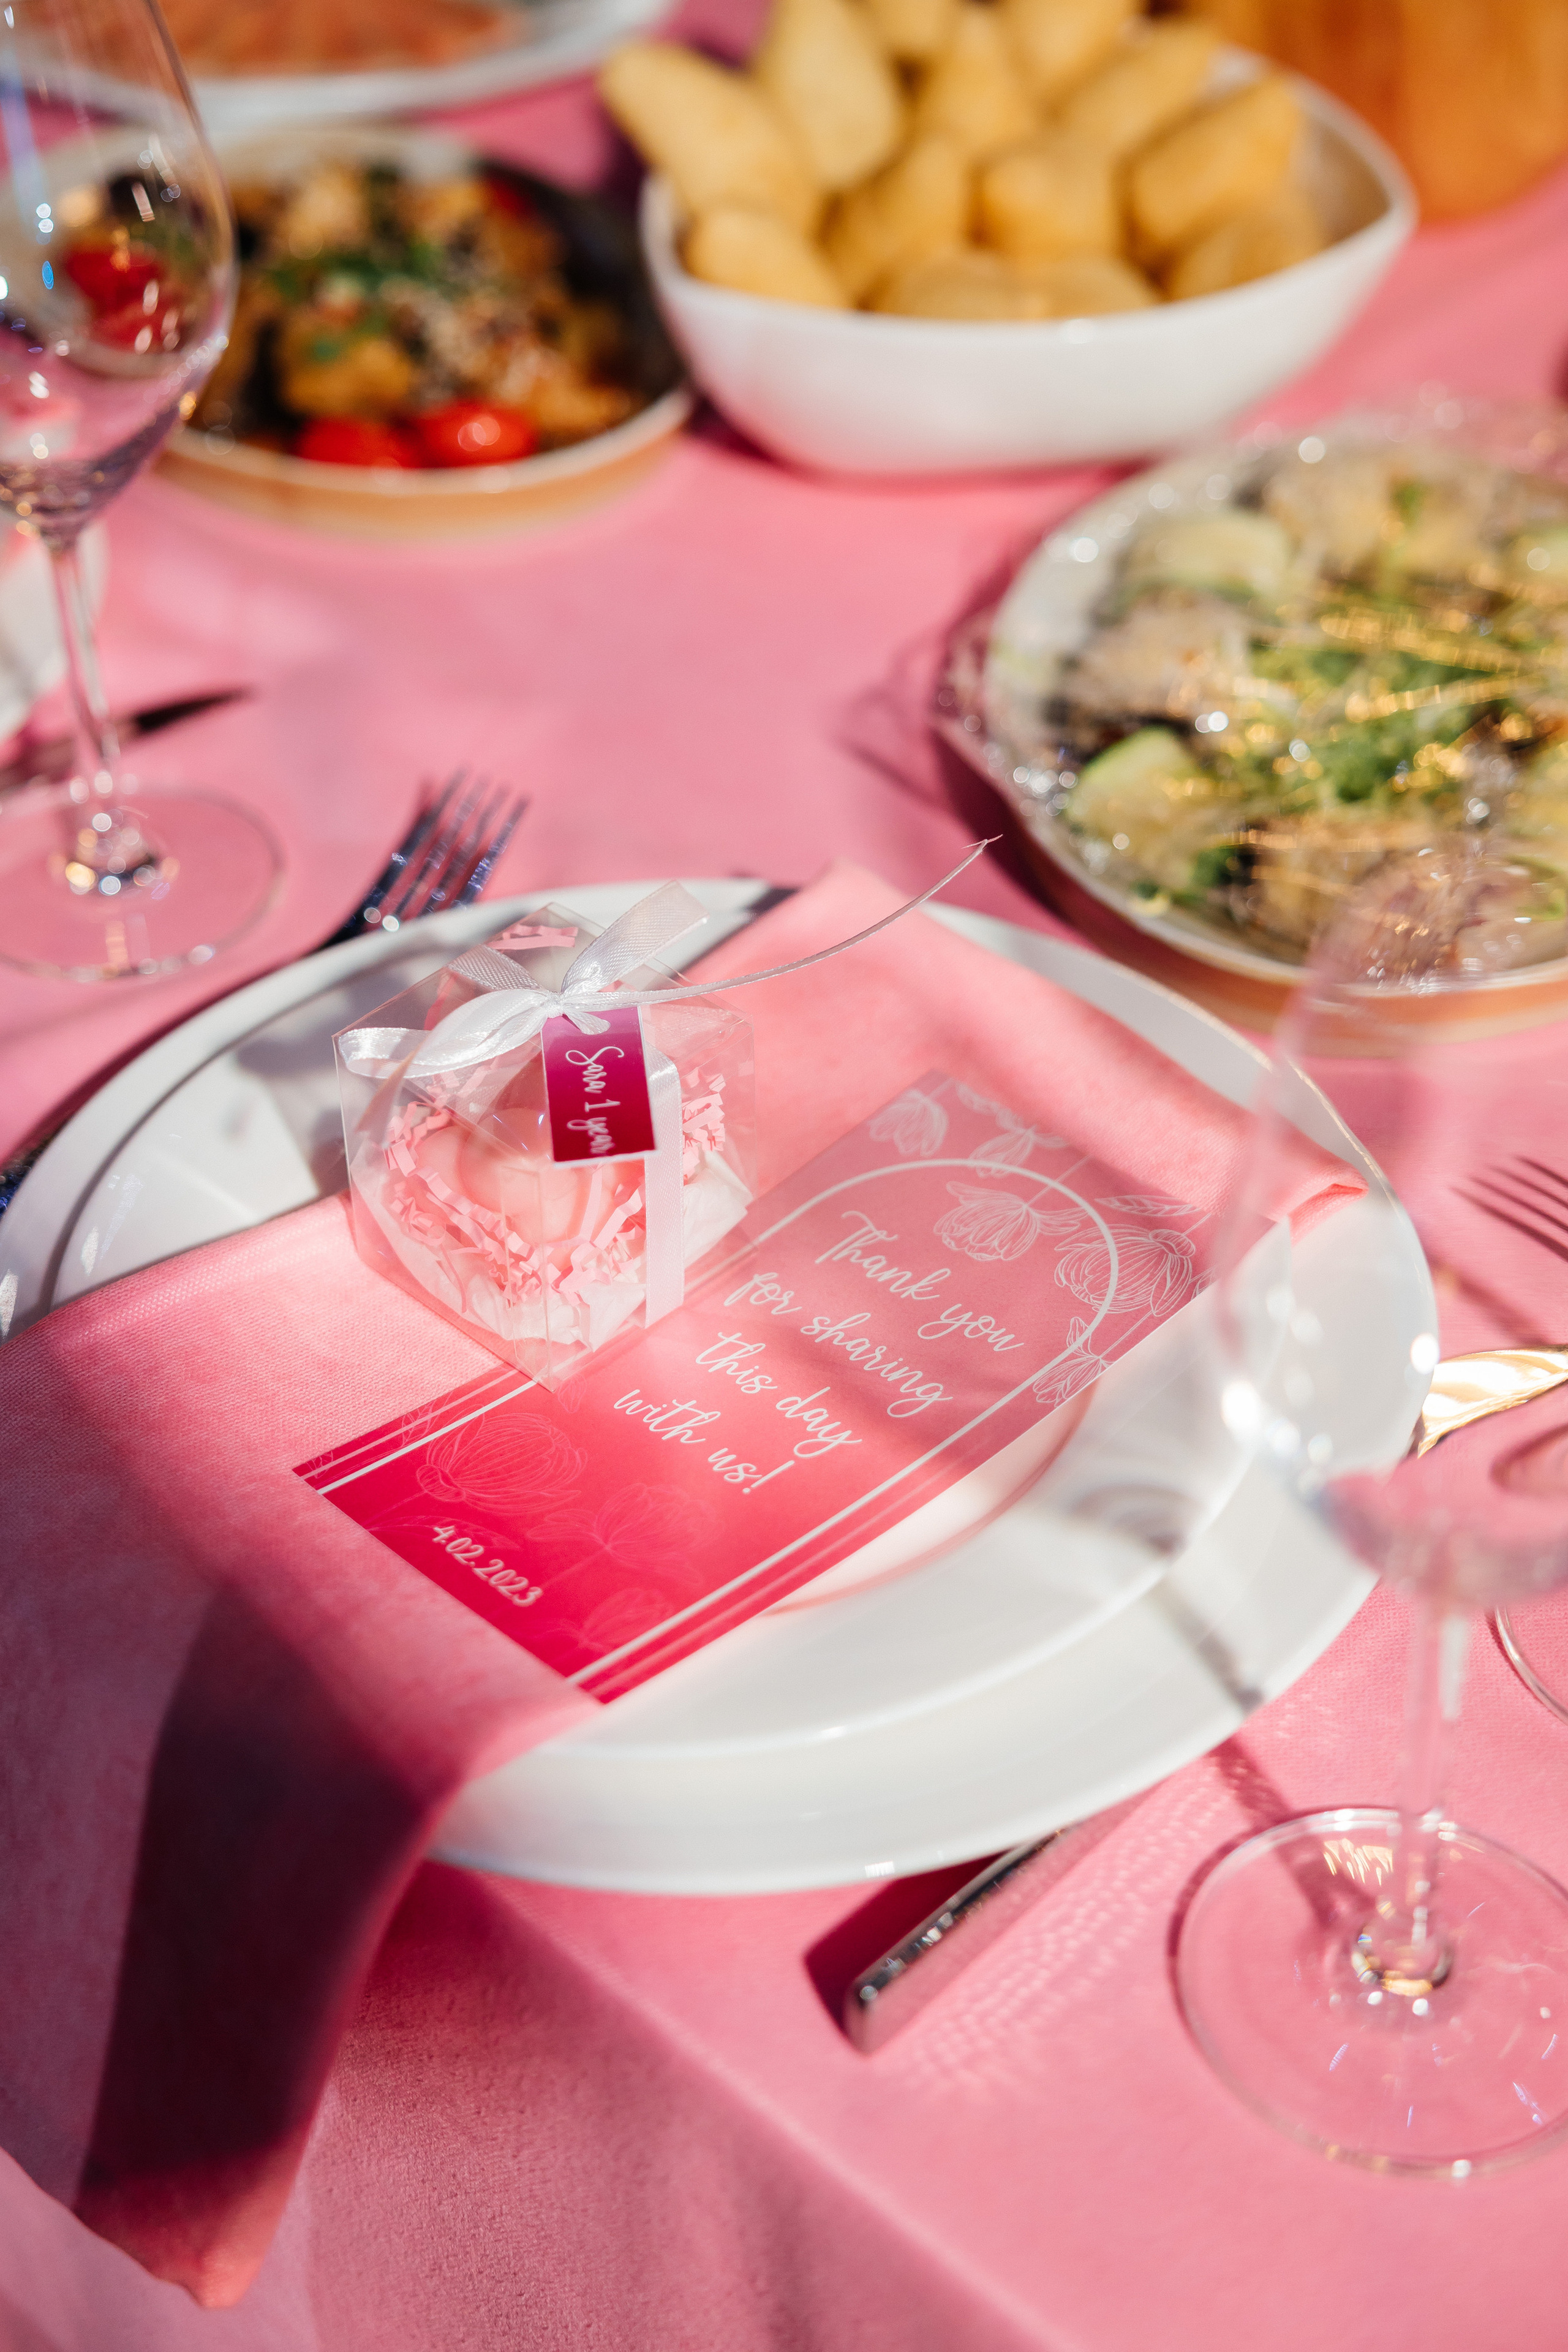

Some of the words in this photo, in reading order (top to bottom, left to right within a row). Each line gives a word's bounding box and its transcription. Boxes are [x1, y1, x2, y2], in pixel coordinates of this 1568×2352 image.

[565, 1046, 625, 1094] Sara
[584, 1098, 621, 1112] 1
[566, 1116, 616, 1155] year
[815, 1210, 951, 1300] Thank
[918, 1303, 1024, 1352] you
[723, 1272, 802, 1314] for
[800, 1313, 953, 1418] sharing
[613, 1389, 721, 1443] with
[707, 1448, 795, 1493] us!
[695, 1332, 778, 1393] this
[775, 1387, 862, 1457] day
[432, 1525, 544, 1607] 4.02.2023
